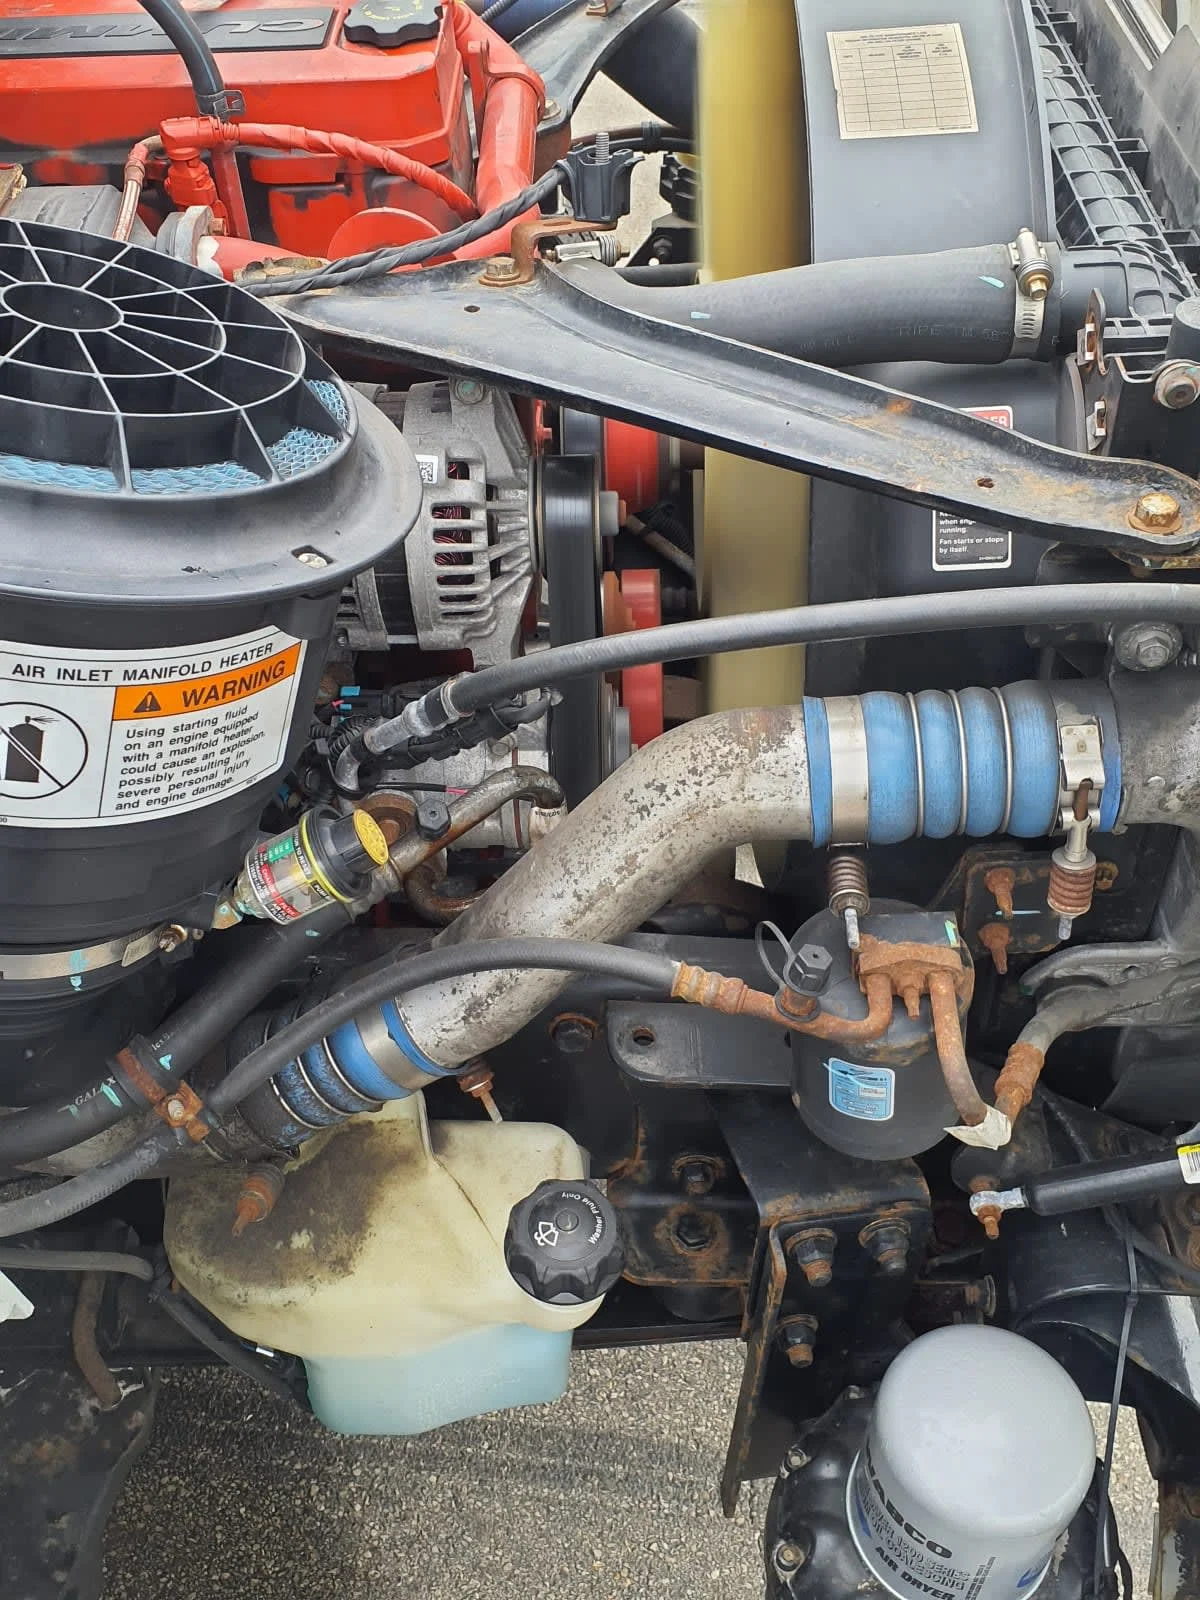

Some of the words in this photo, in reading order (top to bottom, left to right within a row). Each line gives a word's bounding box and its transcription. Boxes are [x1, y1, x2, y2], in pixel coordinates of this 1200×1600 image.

[12, 664, 46, 679] AIR
[56, 668, 113, 682] INLET
[122, 660, 212, 681] MANIFOLD
[220, 642, 274, 669] HEATER
[182, 660, 286, 708] WARNING
[124, 742, 141, 751] on
[147, 740, 163, 748] an
[169, 731, 208, 745] engine
[214, 712, 258, 736] equipped
[126, 728, 166, 738] Using
[172, 717, 218, 733] starting
[225, 704, 248, 720] fluid
[120, 762, 157, 774] could
[162, 758, 197, 770] cause
[202, 751, 216, 760] an
[220, 730, 266, 754] explosion.
[122, 752, 150, 762] with
[156, 752, 163, 760] a
[169, 736, 218, 757] manifold
[223, 726, 253, 743] heater
[117, 786, 160, 798] severe
[168, 770, 218, 793] personal
[224, 757, 251, 775] injury
[118, 772, 174, 789] possibly
[182, 757, 230, 776] resulting
[236, 750, 244, 760] in
[115, 800, 140, 810] and
[146, 792, 186, 806] engine
[192, 777, 233, 796] damage.
[562, 1192, 581, 1200] Only
[582, 1198, 600, 1214] Fluid
[588, 1216, 603, 1245] Washer
[875, 1546, 899, 1572] AIR
[901, 1571, 956, 1600] DRYER
[887, 1539, 965, 1590] COALESCING
[897, 1536, 924, 1562] 1200
[926, 1559, 971, 1581] SERIES
